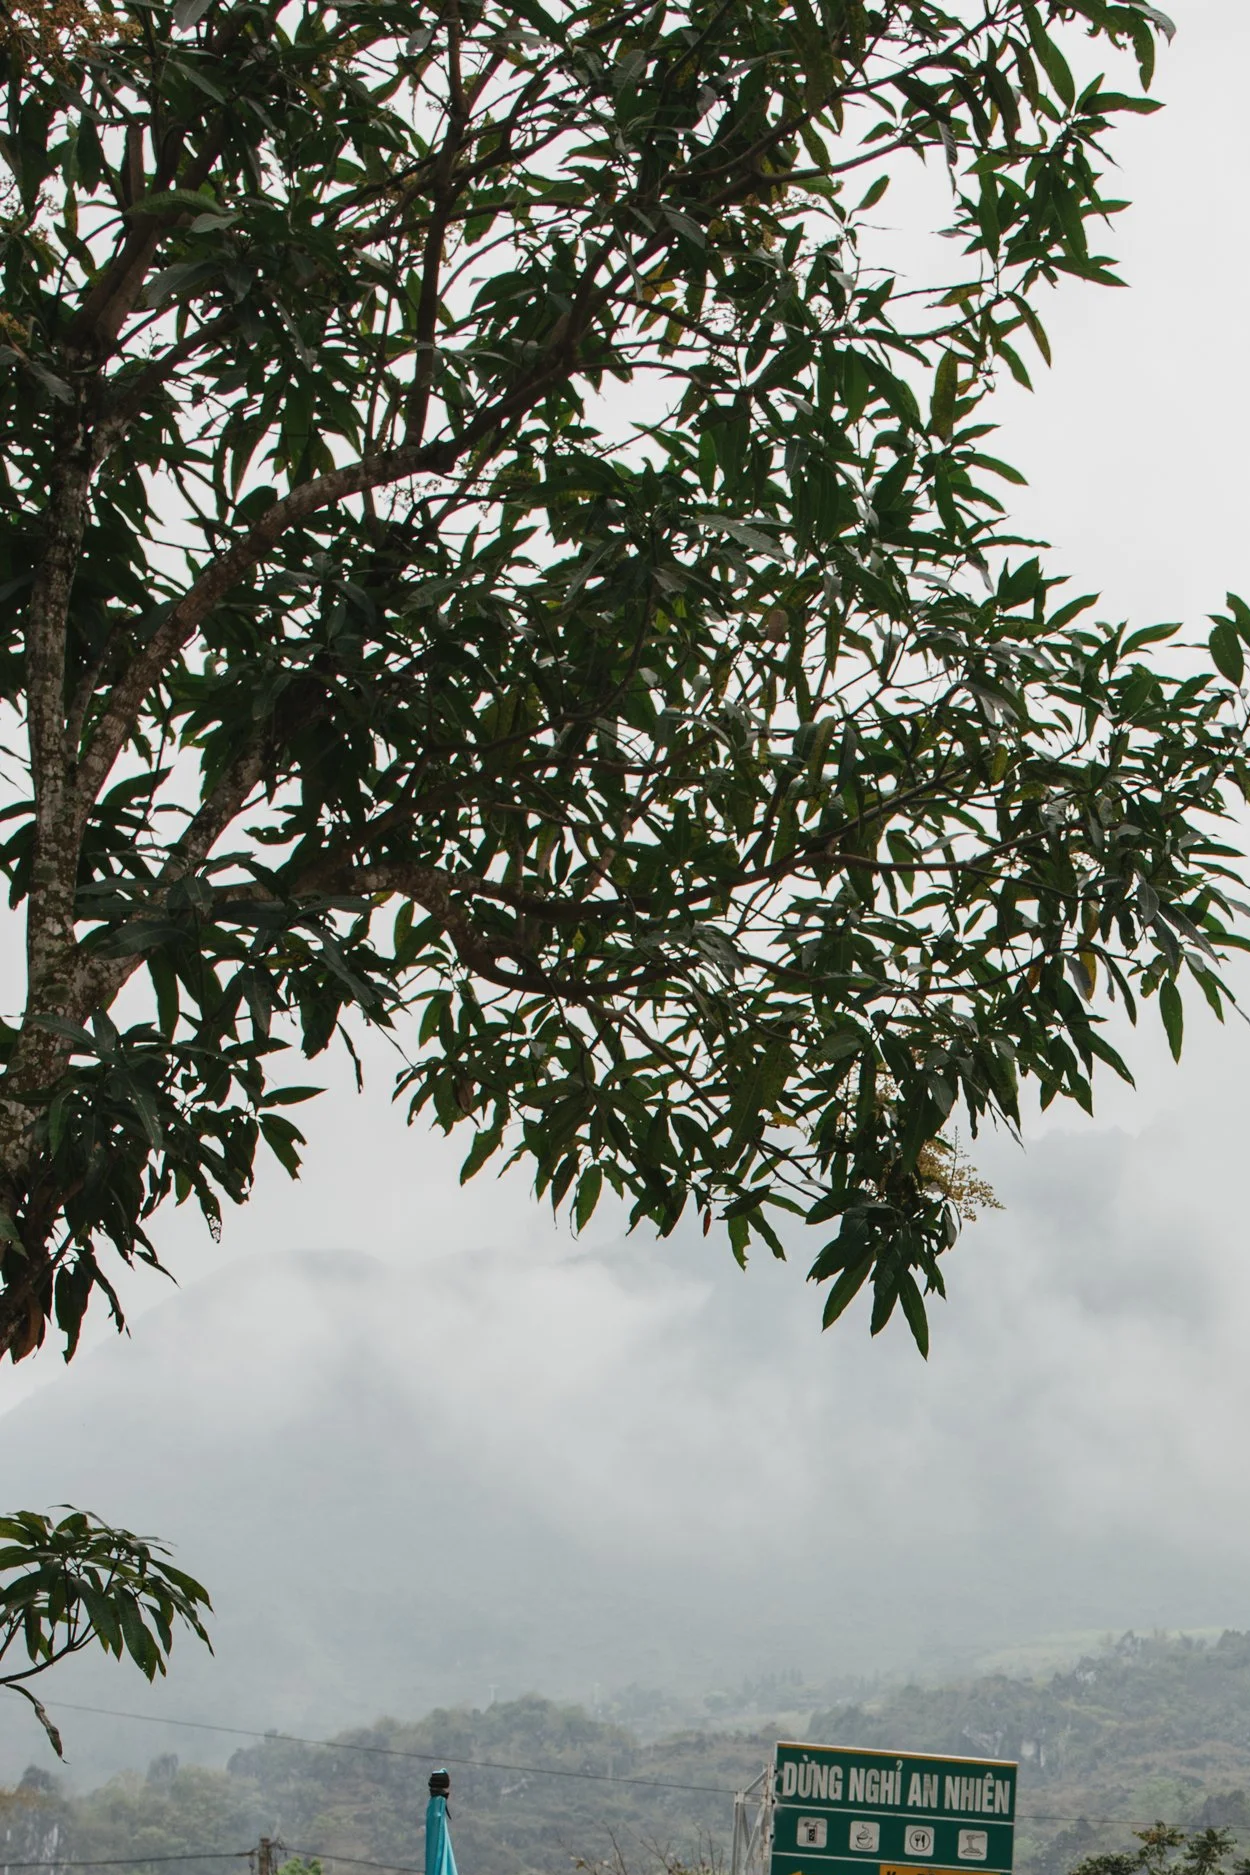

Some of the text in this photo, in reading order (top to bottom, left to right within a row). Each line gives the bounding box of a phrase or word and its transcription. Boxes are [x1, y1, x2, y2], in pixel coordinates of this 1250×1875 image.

[782, 1754, 1011, 1815] DỪNG NGHỈ AN NHIÊN
